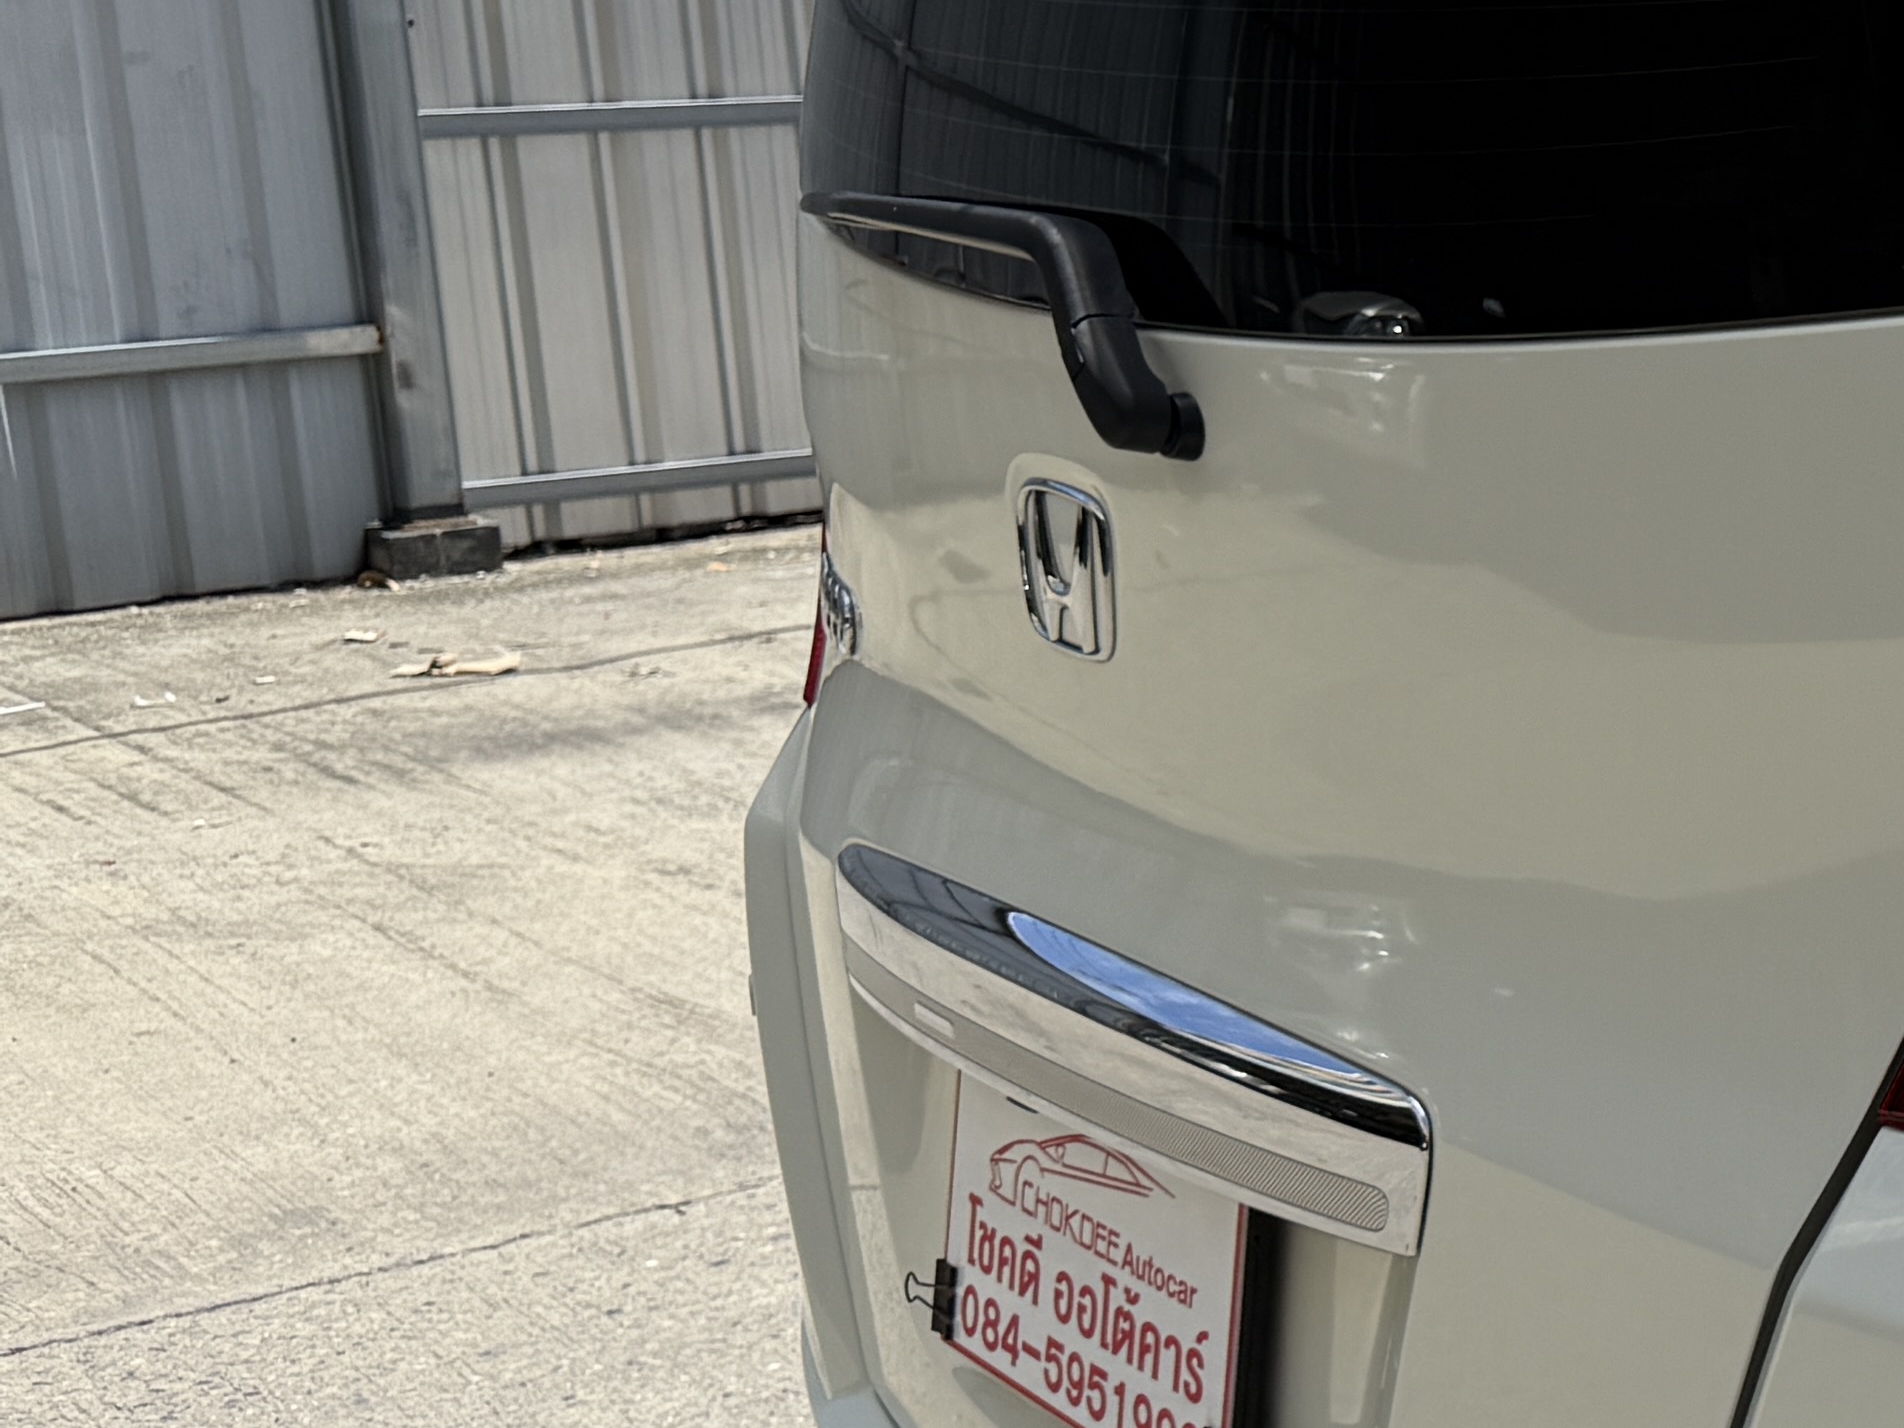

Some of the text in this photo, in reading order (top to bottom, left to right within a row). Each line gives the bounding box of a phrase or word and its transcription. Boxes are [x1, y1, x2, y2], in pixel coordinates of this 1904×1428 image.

[966, 1191, 1210, 1405] โชคดี ออโต้คาร์
[1020, 1179, 1198, 1310] CHOKDEE Autocar
